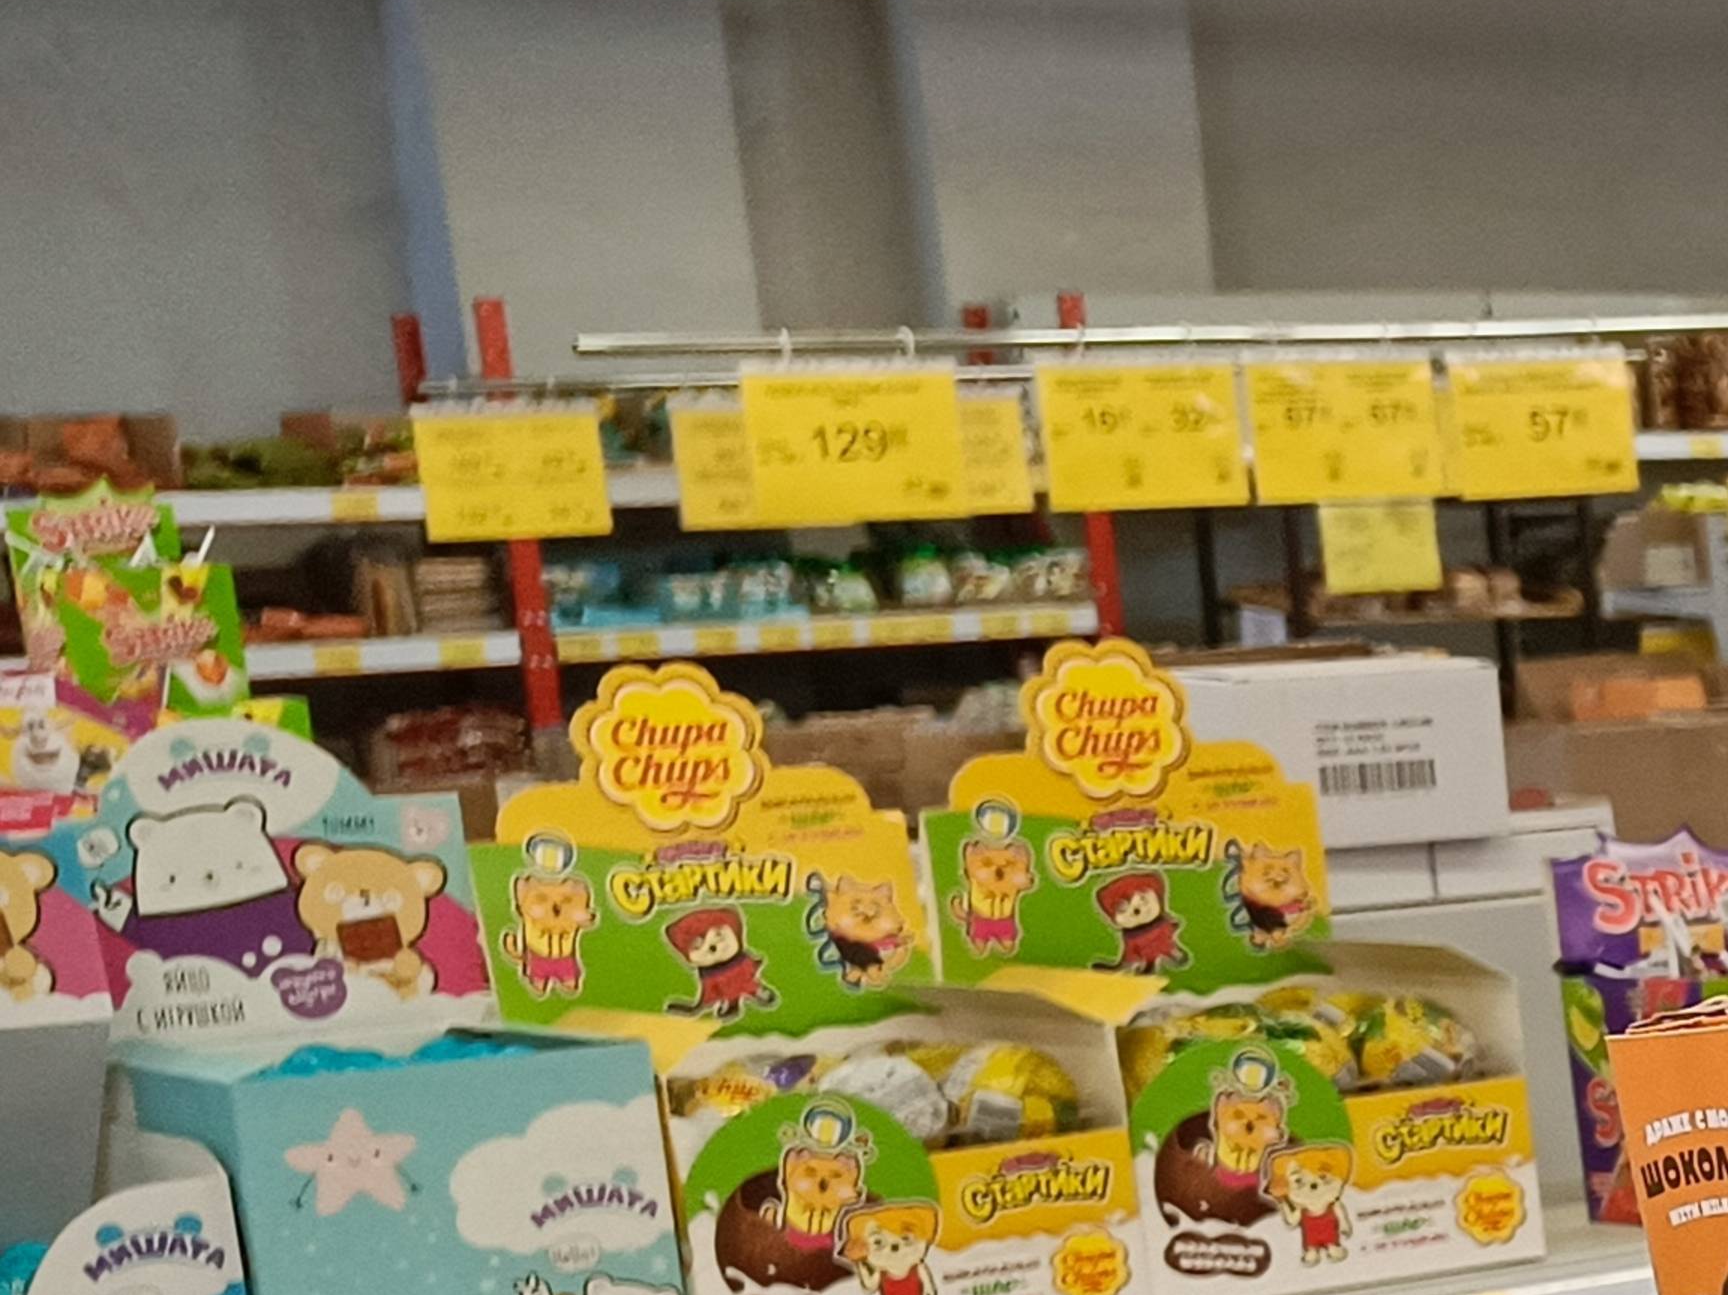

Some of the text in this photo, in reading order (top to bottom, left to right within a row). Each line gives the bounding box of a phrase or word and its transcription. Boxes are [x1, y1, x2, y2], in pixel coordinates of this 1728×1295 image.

[811, 425, 888, 462] 129
[1052, 689, 1158, 723] Chupa
[608, 716, 730, 753] Chupa
[1053, 719, 1163, 773] Chups
[156, 742, 293, 792] МИШАТА
[608, 751, 734, 807] Chups
[529, 1182, 659, 1230] МИШАТА
[83, 1230, 227, 1283] МИШАТА
